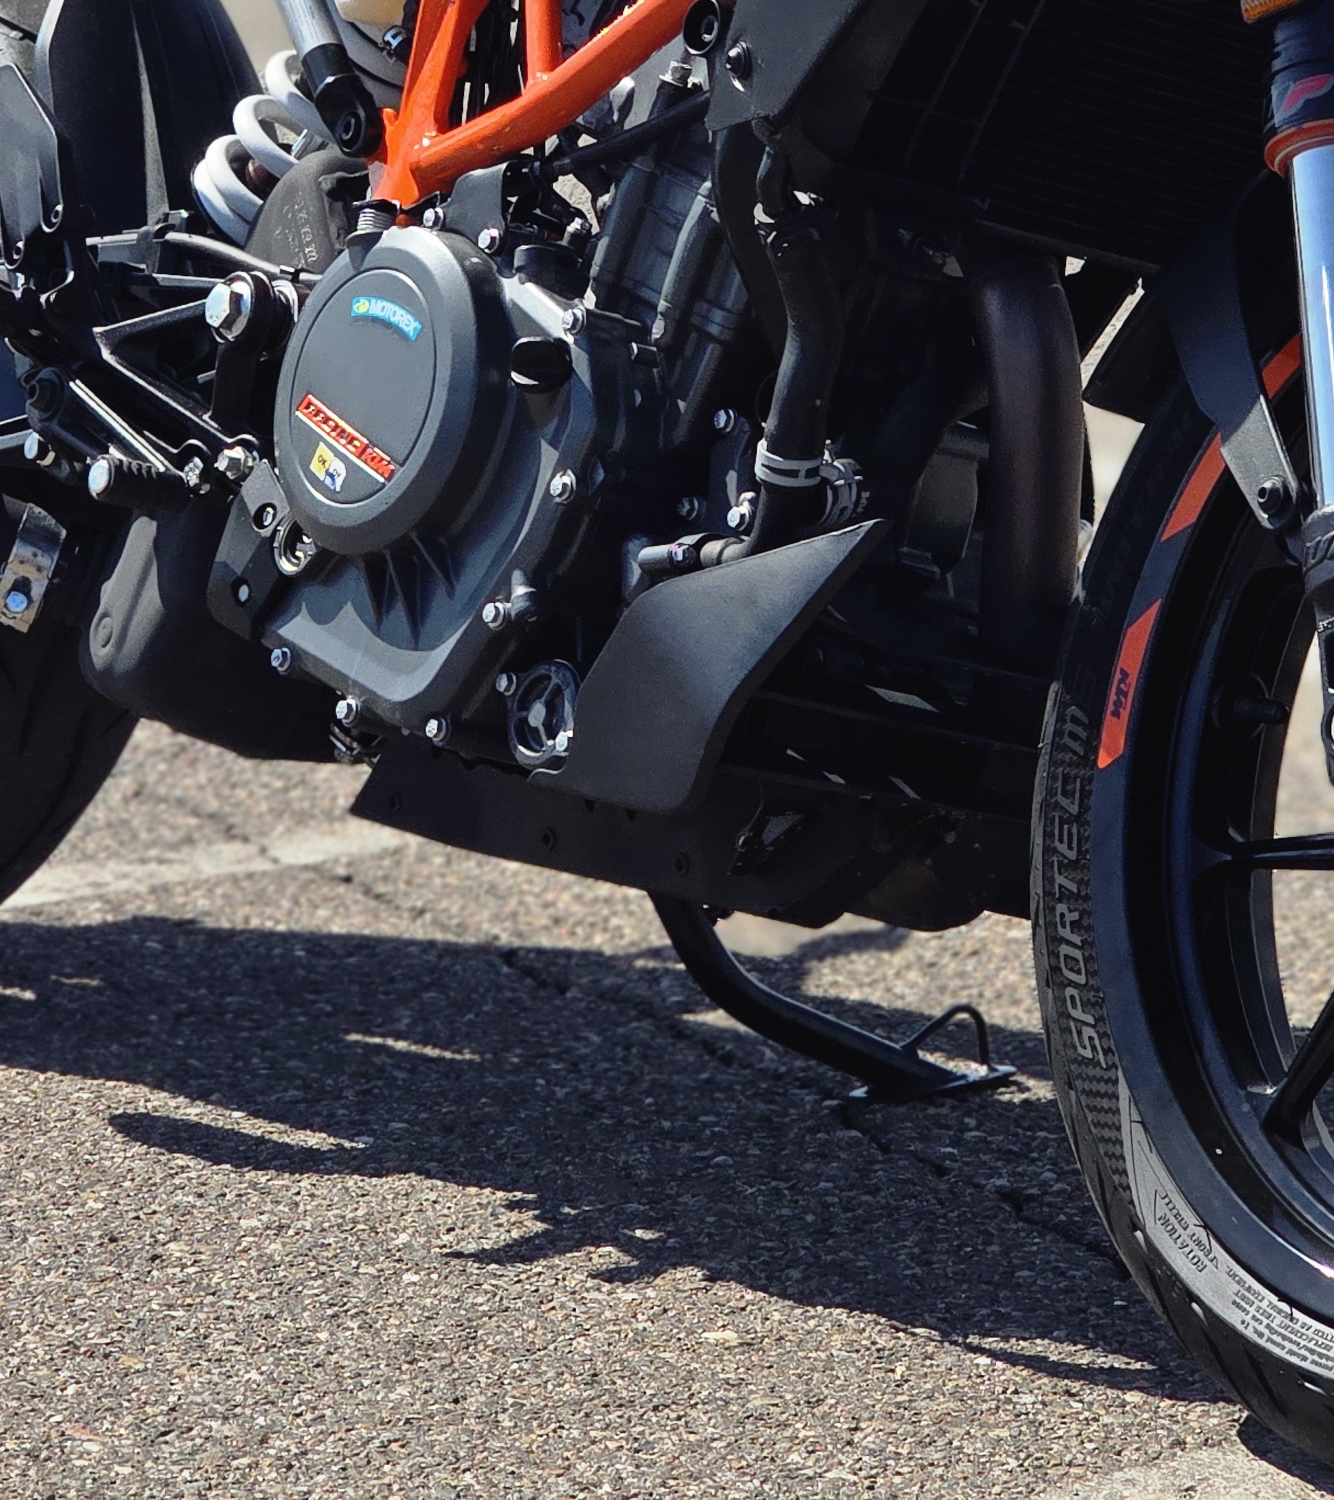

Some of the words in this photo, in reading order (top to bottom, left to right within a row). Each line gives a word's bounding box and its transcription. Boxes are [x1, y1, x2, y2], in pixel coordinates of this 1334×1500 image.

[369, 298, 423, 338] MOTOREX
[1110, 666, 1132, 720] KTM
[1053, 767, 1108, 1069] SPORTEC
